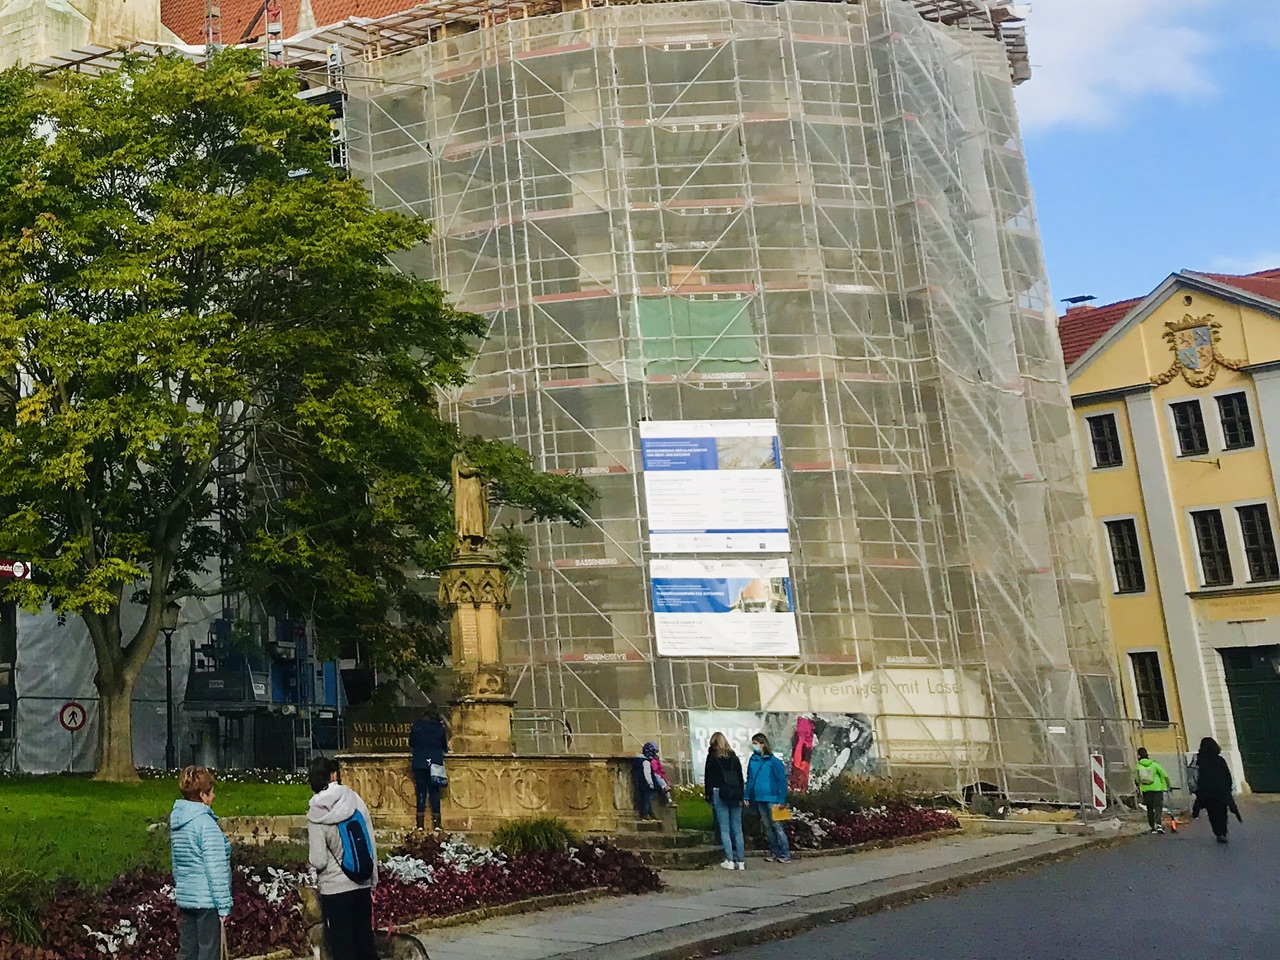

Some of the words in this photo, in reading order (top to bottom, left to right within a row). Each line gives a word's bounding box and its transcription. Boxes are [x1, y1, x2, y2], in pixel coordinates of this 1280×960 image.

[784, 679, 812, 695] Wir
[823, 680, 888, 699] reinigen
[897, 679, 919, 694] mit
[380, 723, 413, 733] HABE
